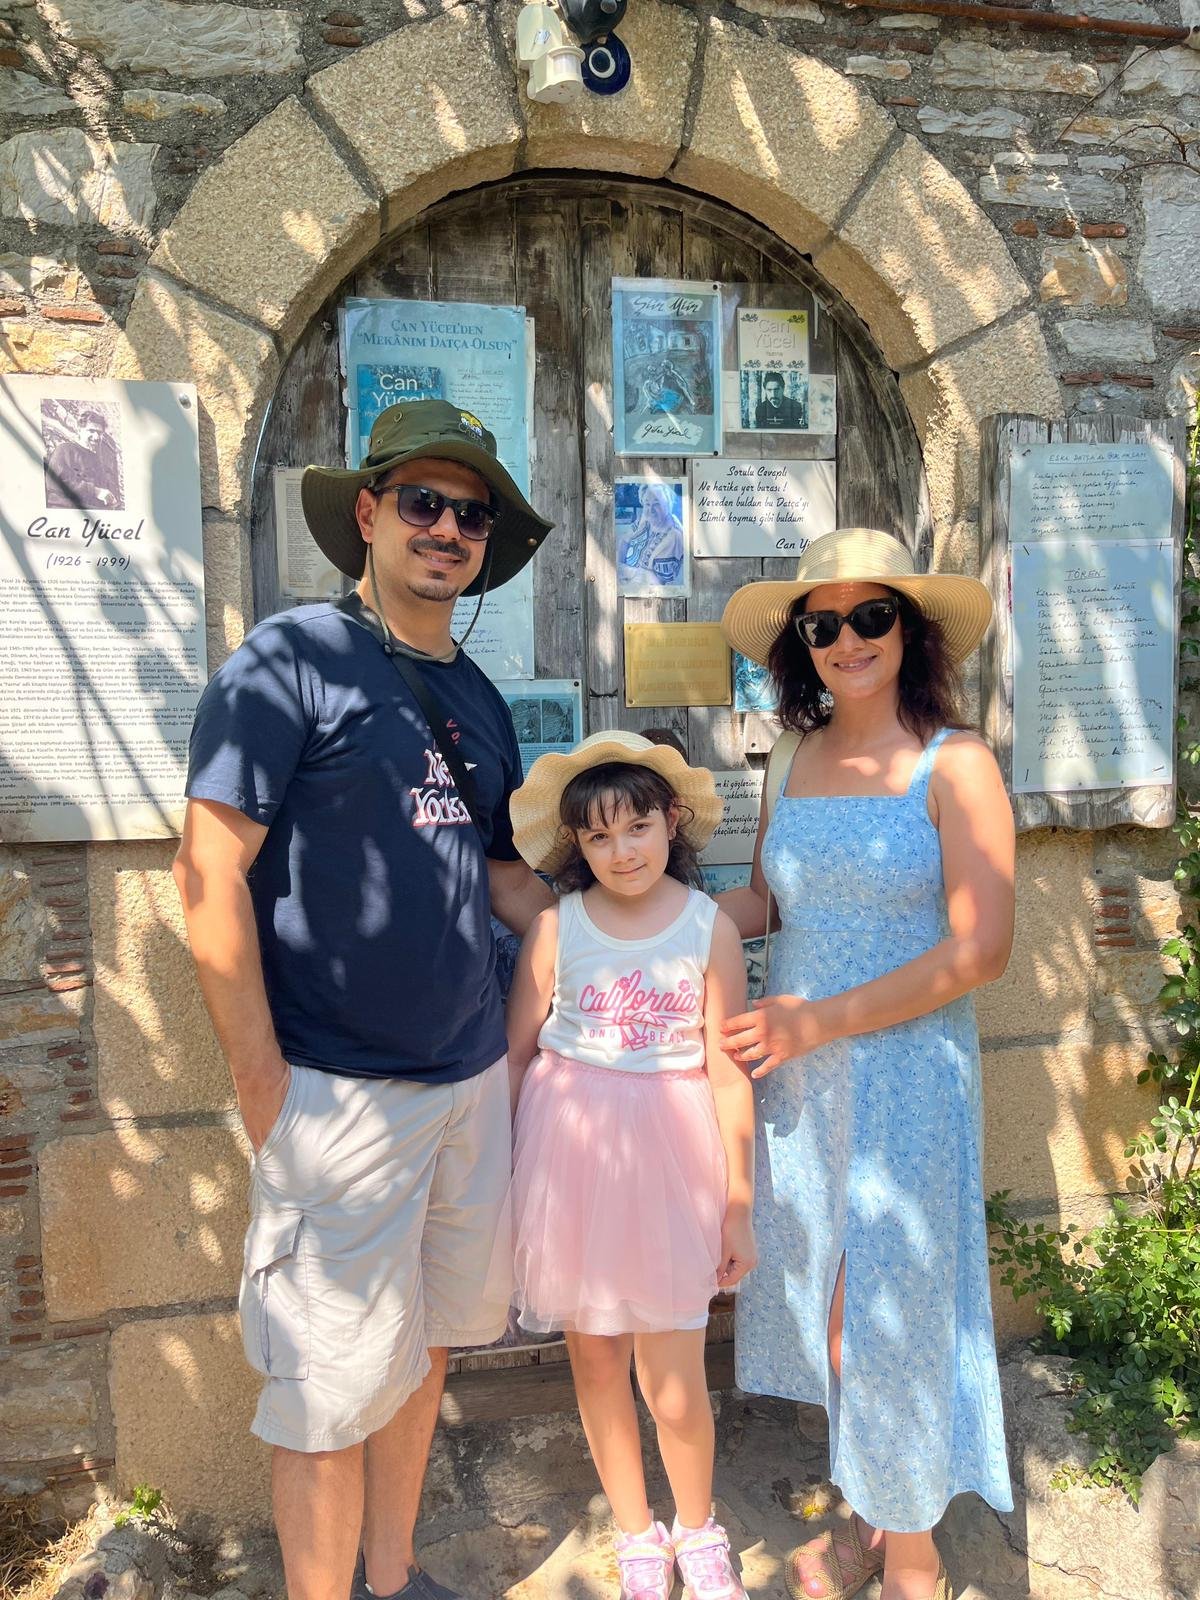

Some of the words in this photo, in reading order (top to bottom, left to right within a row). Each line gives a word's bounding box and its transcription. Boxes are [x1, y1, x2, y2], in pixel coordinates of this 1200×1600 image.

[391, 320, 417, 332] CAN
[421, 320, 483, 335] YÜCEL'DEN
[759, 319, 790, 333] Can
[754, 334, 796, 349] Yücel
[380, 374, 418, 391] Can
[727, 466, 754, 476] Sorulu
[757, 466, 787, 480] Cevaplı
[698, 481, 710, 491] Ne
[713, 481, 738, 491] harika
[741, 484, 754, 495] yer
[757, 482, 780, 492] burası
[698, 497, 733, 507] Nereden
[736, 496, 761, 507] buldun
[764, 497, 773, 507] bu
[699, 512, 725, 522] Elimle
[728, 512, 757, 526] koymuş
[759, 513, 774, 526] gibi
[776, 512, 804, 523] buldum
[27, 516, 70, 538] Can
[82, 518, 144, 547] Yücel
[776, 538, 795, 549] Can
[46, 553, 81, 569] (1926
[96, 554, 131, 571] 1999)
[579, 969, 697, 1018] California
